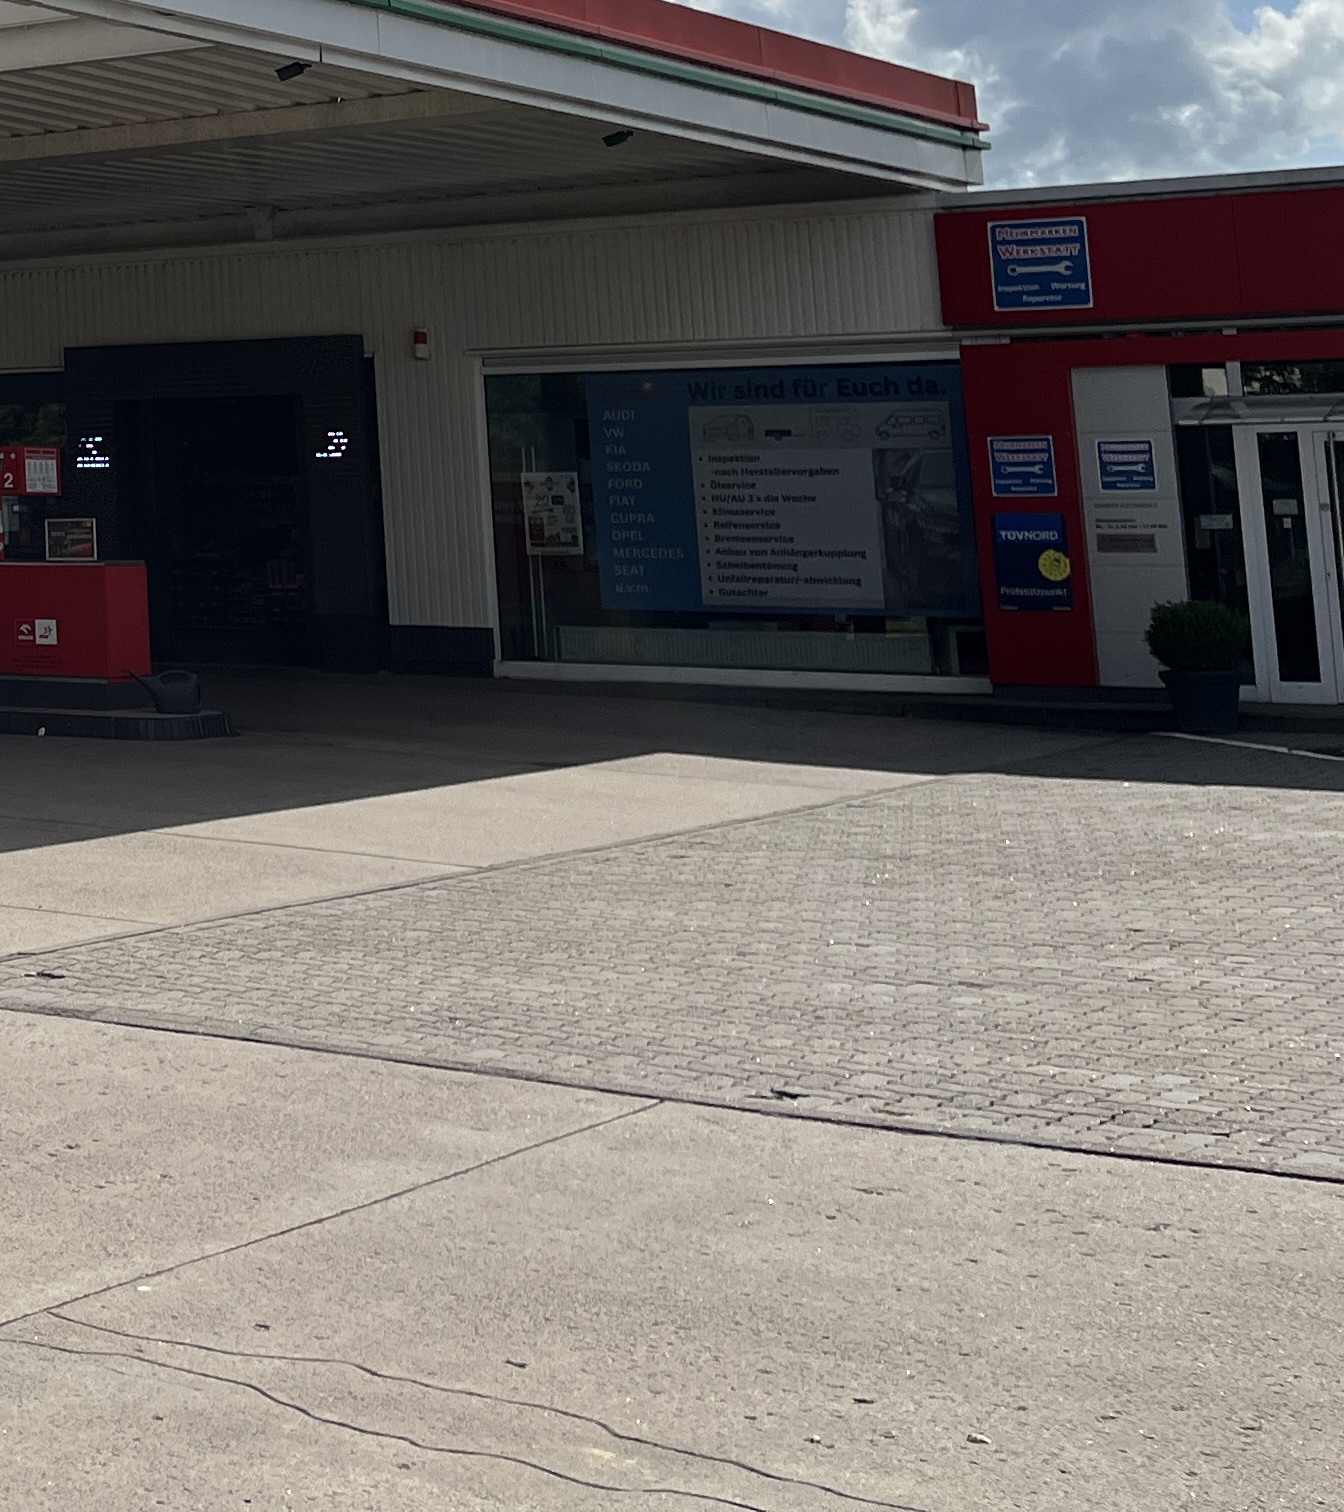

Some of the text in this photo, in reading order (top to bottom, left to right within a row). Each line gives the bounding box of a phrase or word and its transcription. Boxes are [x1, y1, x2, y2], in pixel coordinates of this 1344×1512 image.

[686, 374, 947, 400] Wir sind für Euch da.
[603, 409, 635, 422] AUDI
[603, 427, 624, 439] VW
[605, 445, 627, 456] KIA
[708, 454, 760, 464] Inspektion
[3, 472, 14, 488] 2
[608, 478, 643, 490] FORD
[710, 479, 757, 490] Ölservice
[609, 495, 636, 506] FIAT
[711, 494, 745, 504] HU/AU
[712, 507, 776, 516] Klimaservice
[610, 512, 655, 524] CUPRA
[713, 521, 781, 530] Reifenservice
[611, 529, 644, 541] OPEL
[714, 534, 794, 544] Bremsenservice
[612, 547, 685, 559] MERCEDES
[715, 548, 747, 557] Anbau
[749, 549, 768, 557] von
[614, 564, 645, 576] SEAT
[716, 561, 799, 572] Scheibentönung
[718, 588, 769, 597] Gutachter
